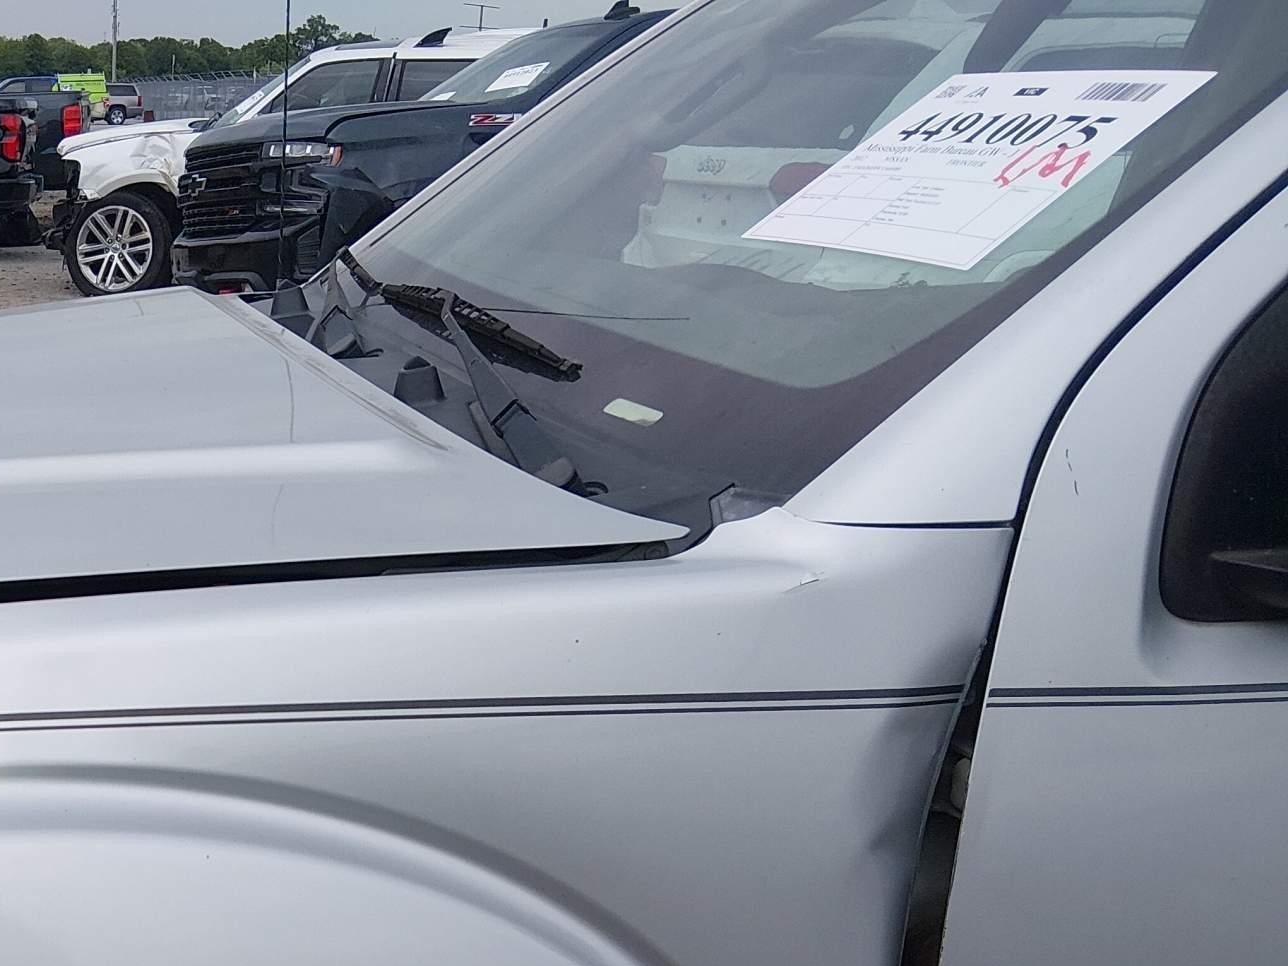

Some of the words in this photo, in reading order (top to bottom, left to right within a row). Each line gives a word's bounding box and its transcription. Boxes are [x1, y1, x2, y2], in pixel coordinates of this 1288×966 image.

[898, 111, 1118, 149] 44910075
[866, 144, 913, 155] Mississippi
[912, 144, 941, 154] Farm
[940, 144, 978, 156] Bureau
